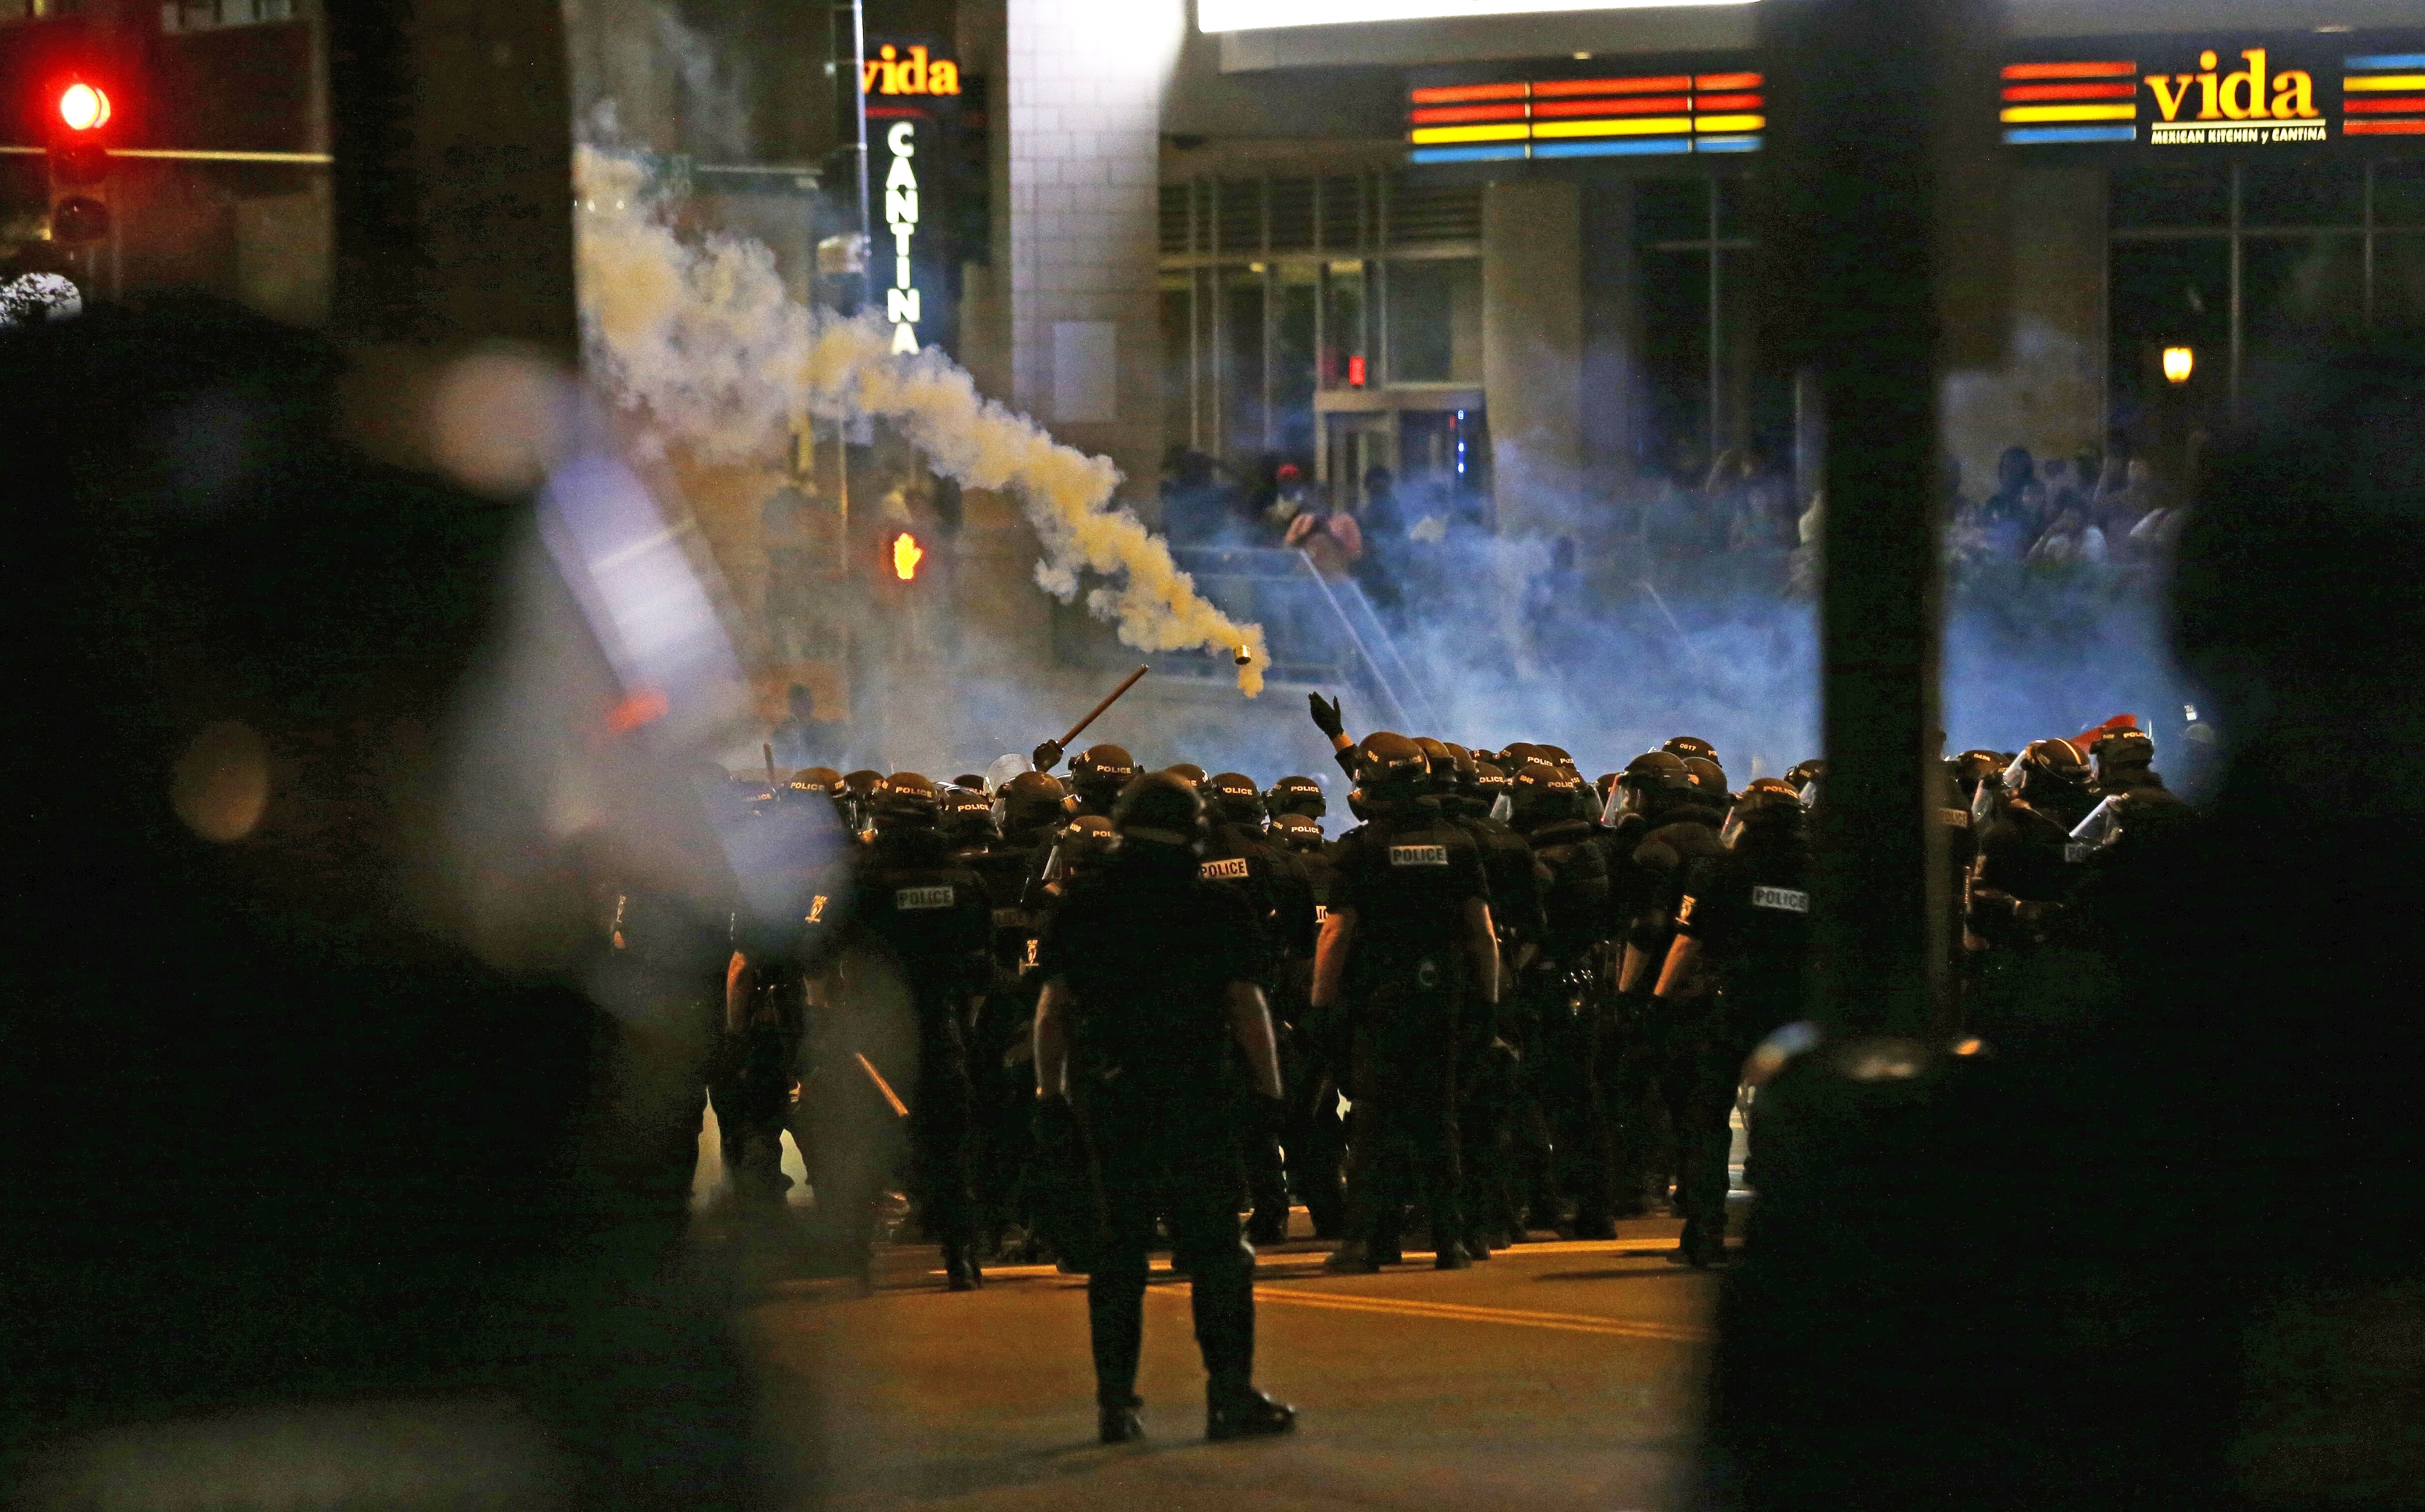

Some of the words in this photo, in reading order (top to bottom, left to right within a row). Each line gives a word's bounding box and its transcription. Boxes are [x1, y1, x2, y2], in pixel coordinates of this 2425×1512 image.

[862, 43, 961, 95] vida
[2144, 48, 2319, 122] vida
[2151, 130, 2205, 144] MEXICAN
[2208, 128, 2258, 143] KITCHEN
[2271, 126, 2327, 142] CANTINA
[886, 122, 921, 355] CANTINA
[1097, 765, 1131, 774] POLICE
[896, 787, 932, 798] POLICE
[1392, 847, 1445, 862] POLICE
[897, 888, 951, 907] POLICE
[1755, 889, 1809, 910] POLICE
